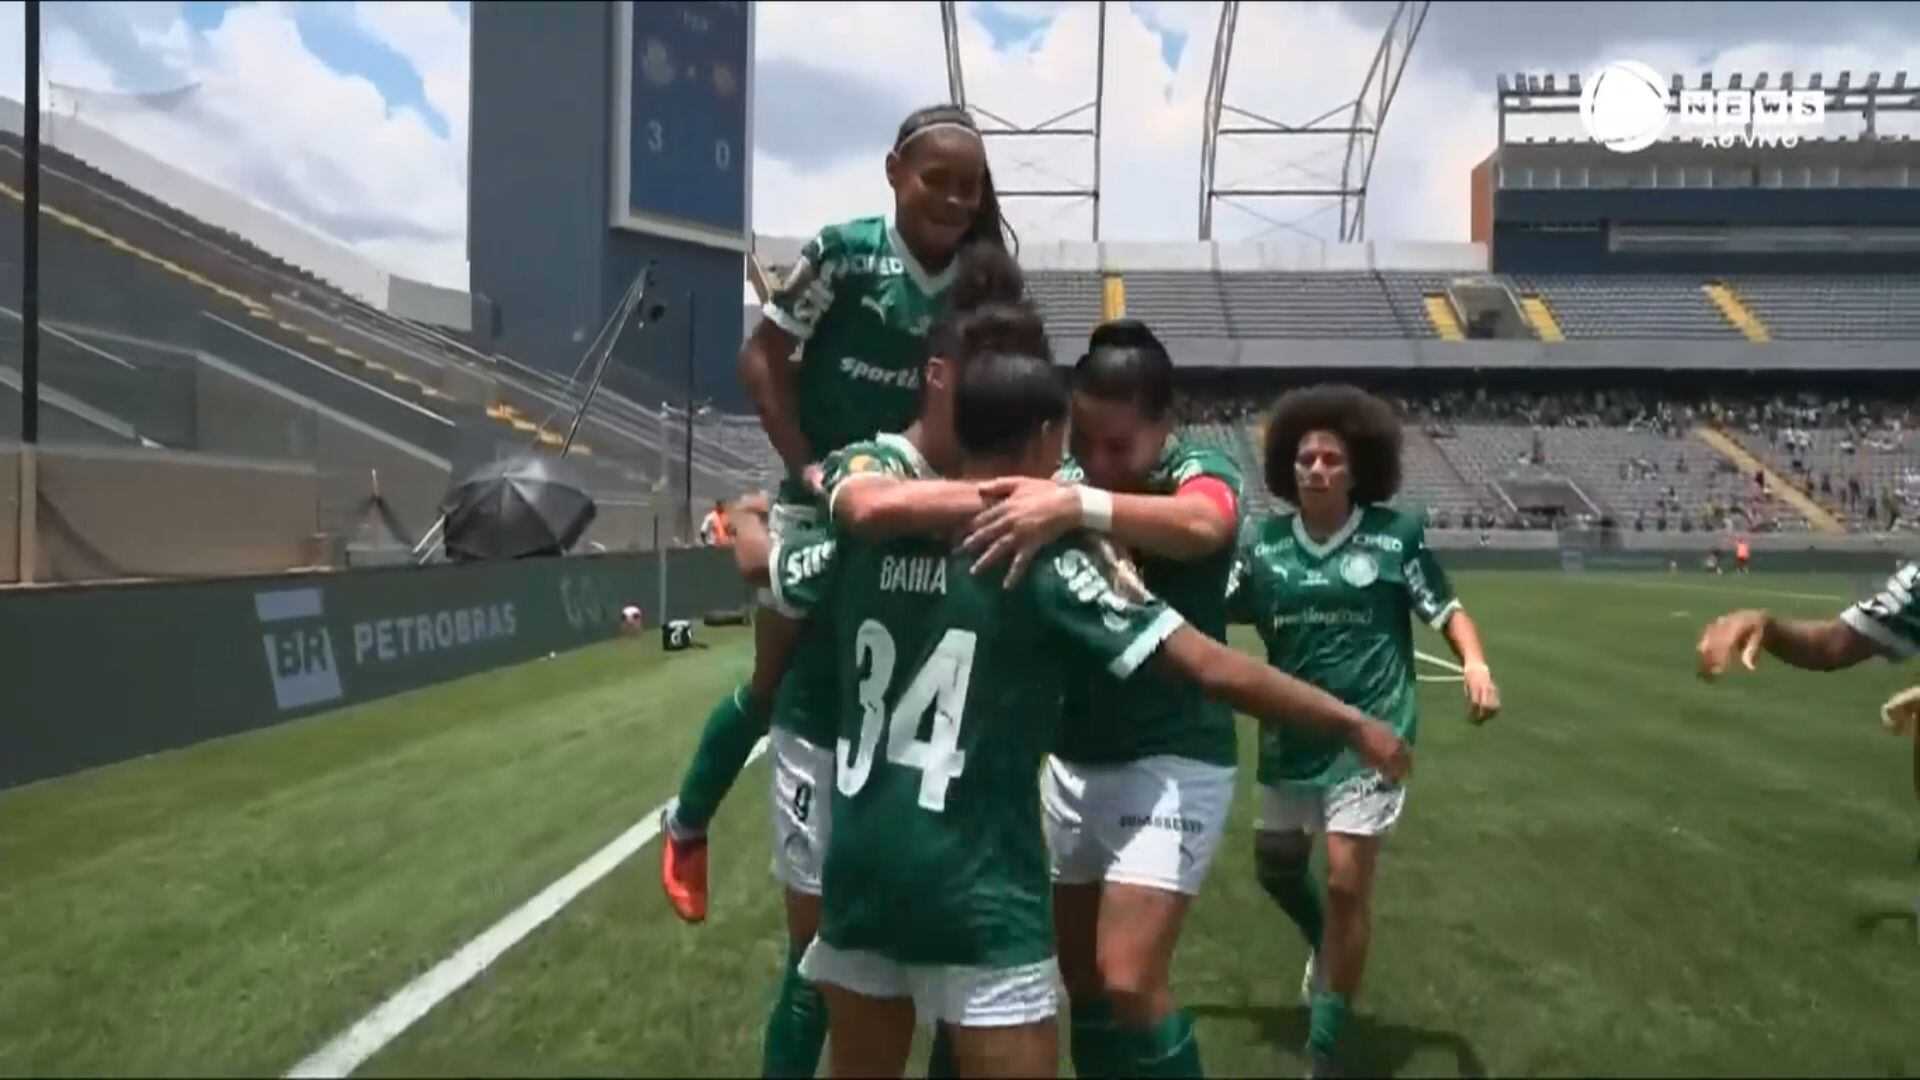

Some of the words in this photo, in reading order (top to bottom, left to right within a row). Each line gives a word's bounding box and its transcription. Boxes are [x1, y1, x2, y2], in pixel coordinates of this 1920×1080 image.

[647, 120, 663, 152] 3
[715, 138, 731, 169] 0
[880, 555, 948, 595] BAHIA
[275, 632, 328, 679] BR
[353, 602, 517, 664] PETROBRAS
[836, 618, 977, 812] 34
[794, 782, 812, 822] 9
